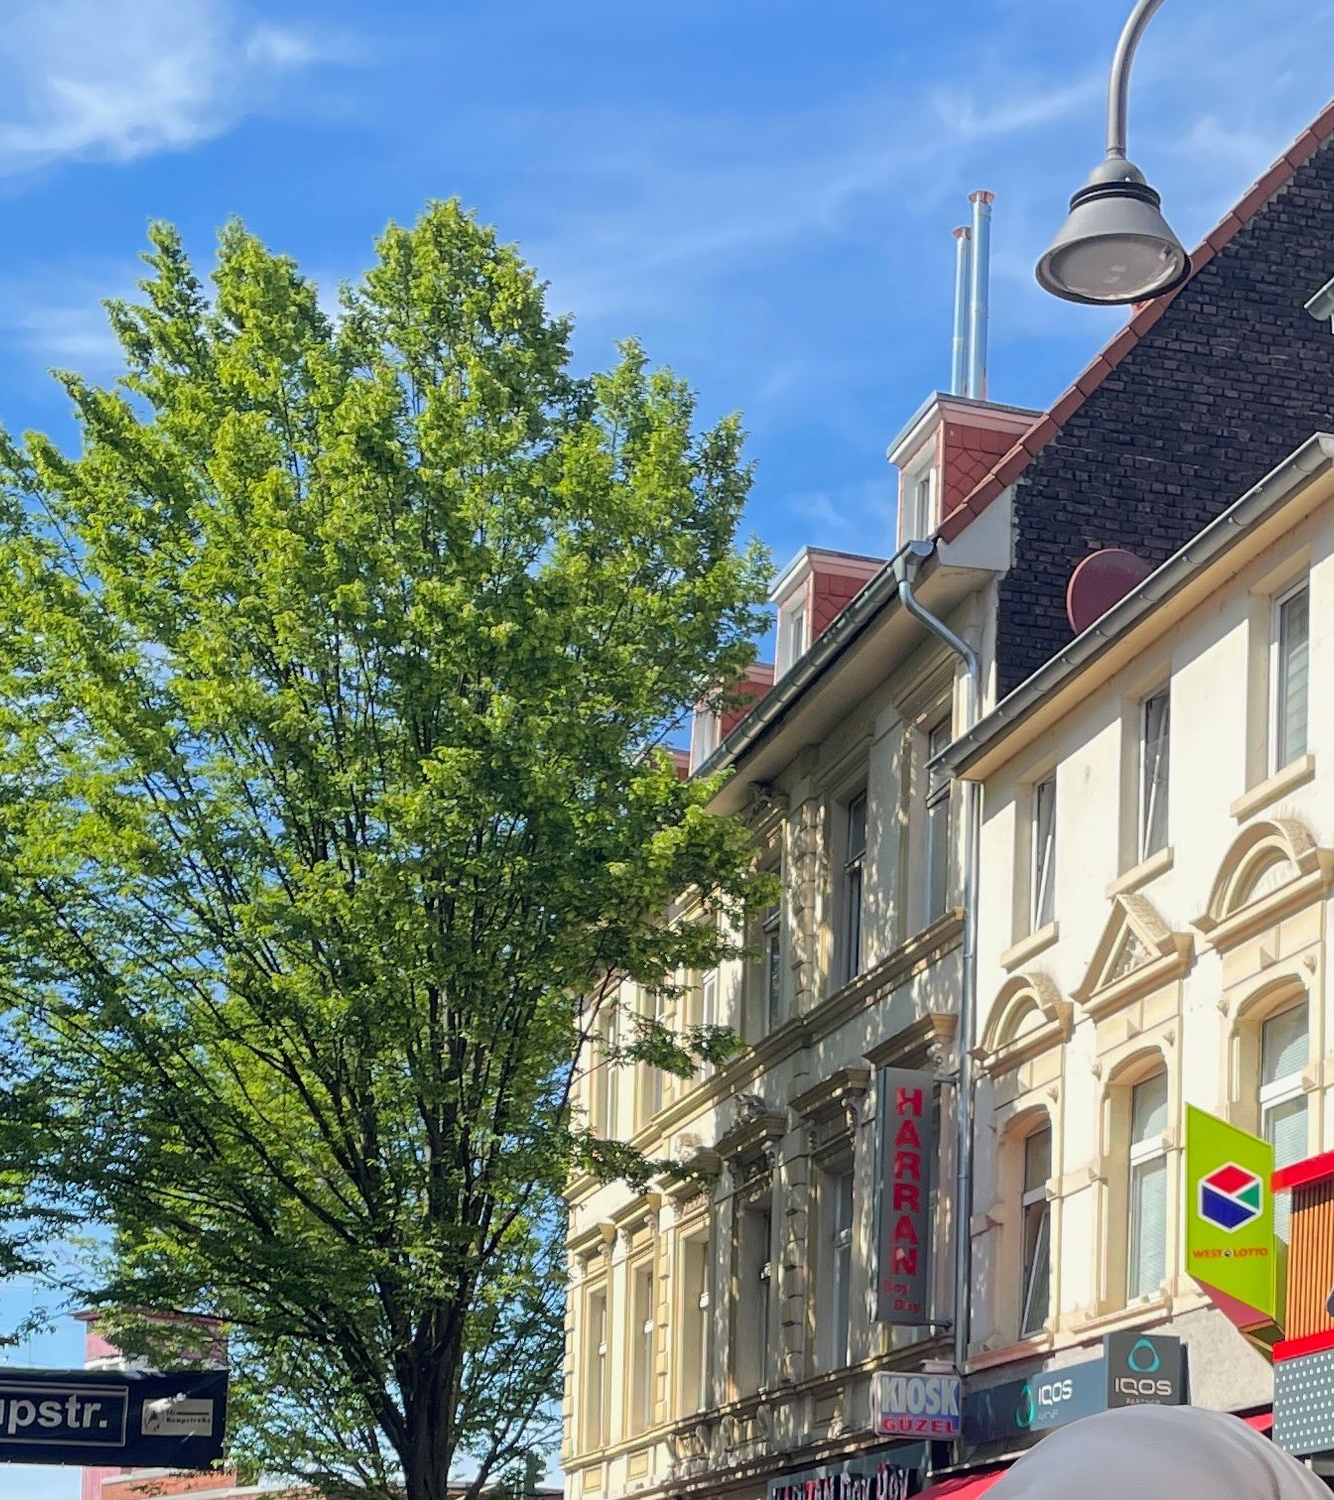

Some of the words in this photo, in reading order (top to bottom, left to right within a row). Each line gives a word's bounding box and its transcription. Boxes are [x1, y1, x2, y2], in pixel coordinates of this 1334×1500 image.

[890, 1087, 924, 1276] HARRAN
[1193, 1248, 1223, 1259] WEST
[1233, 1247, 1269, 1258] LOTTO
[881, 1376, 959, 1416] KIOSK
[1038, 1379, 1072, 1406] IQOS
[1115, 1377, 1172, 1396] IQOS
[882, 1416, 959, 1434] GÜZEL
